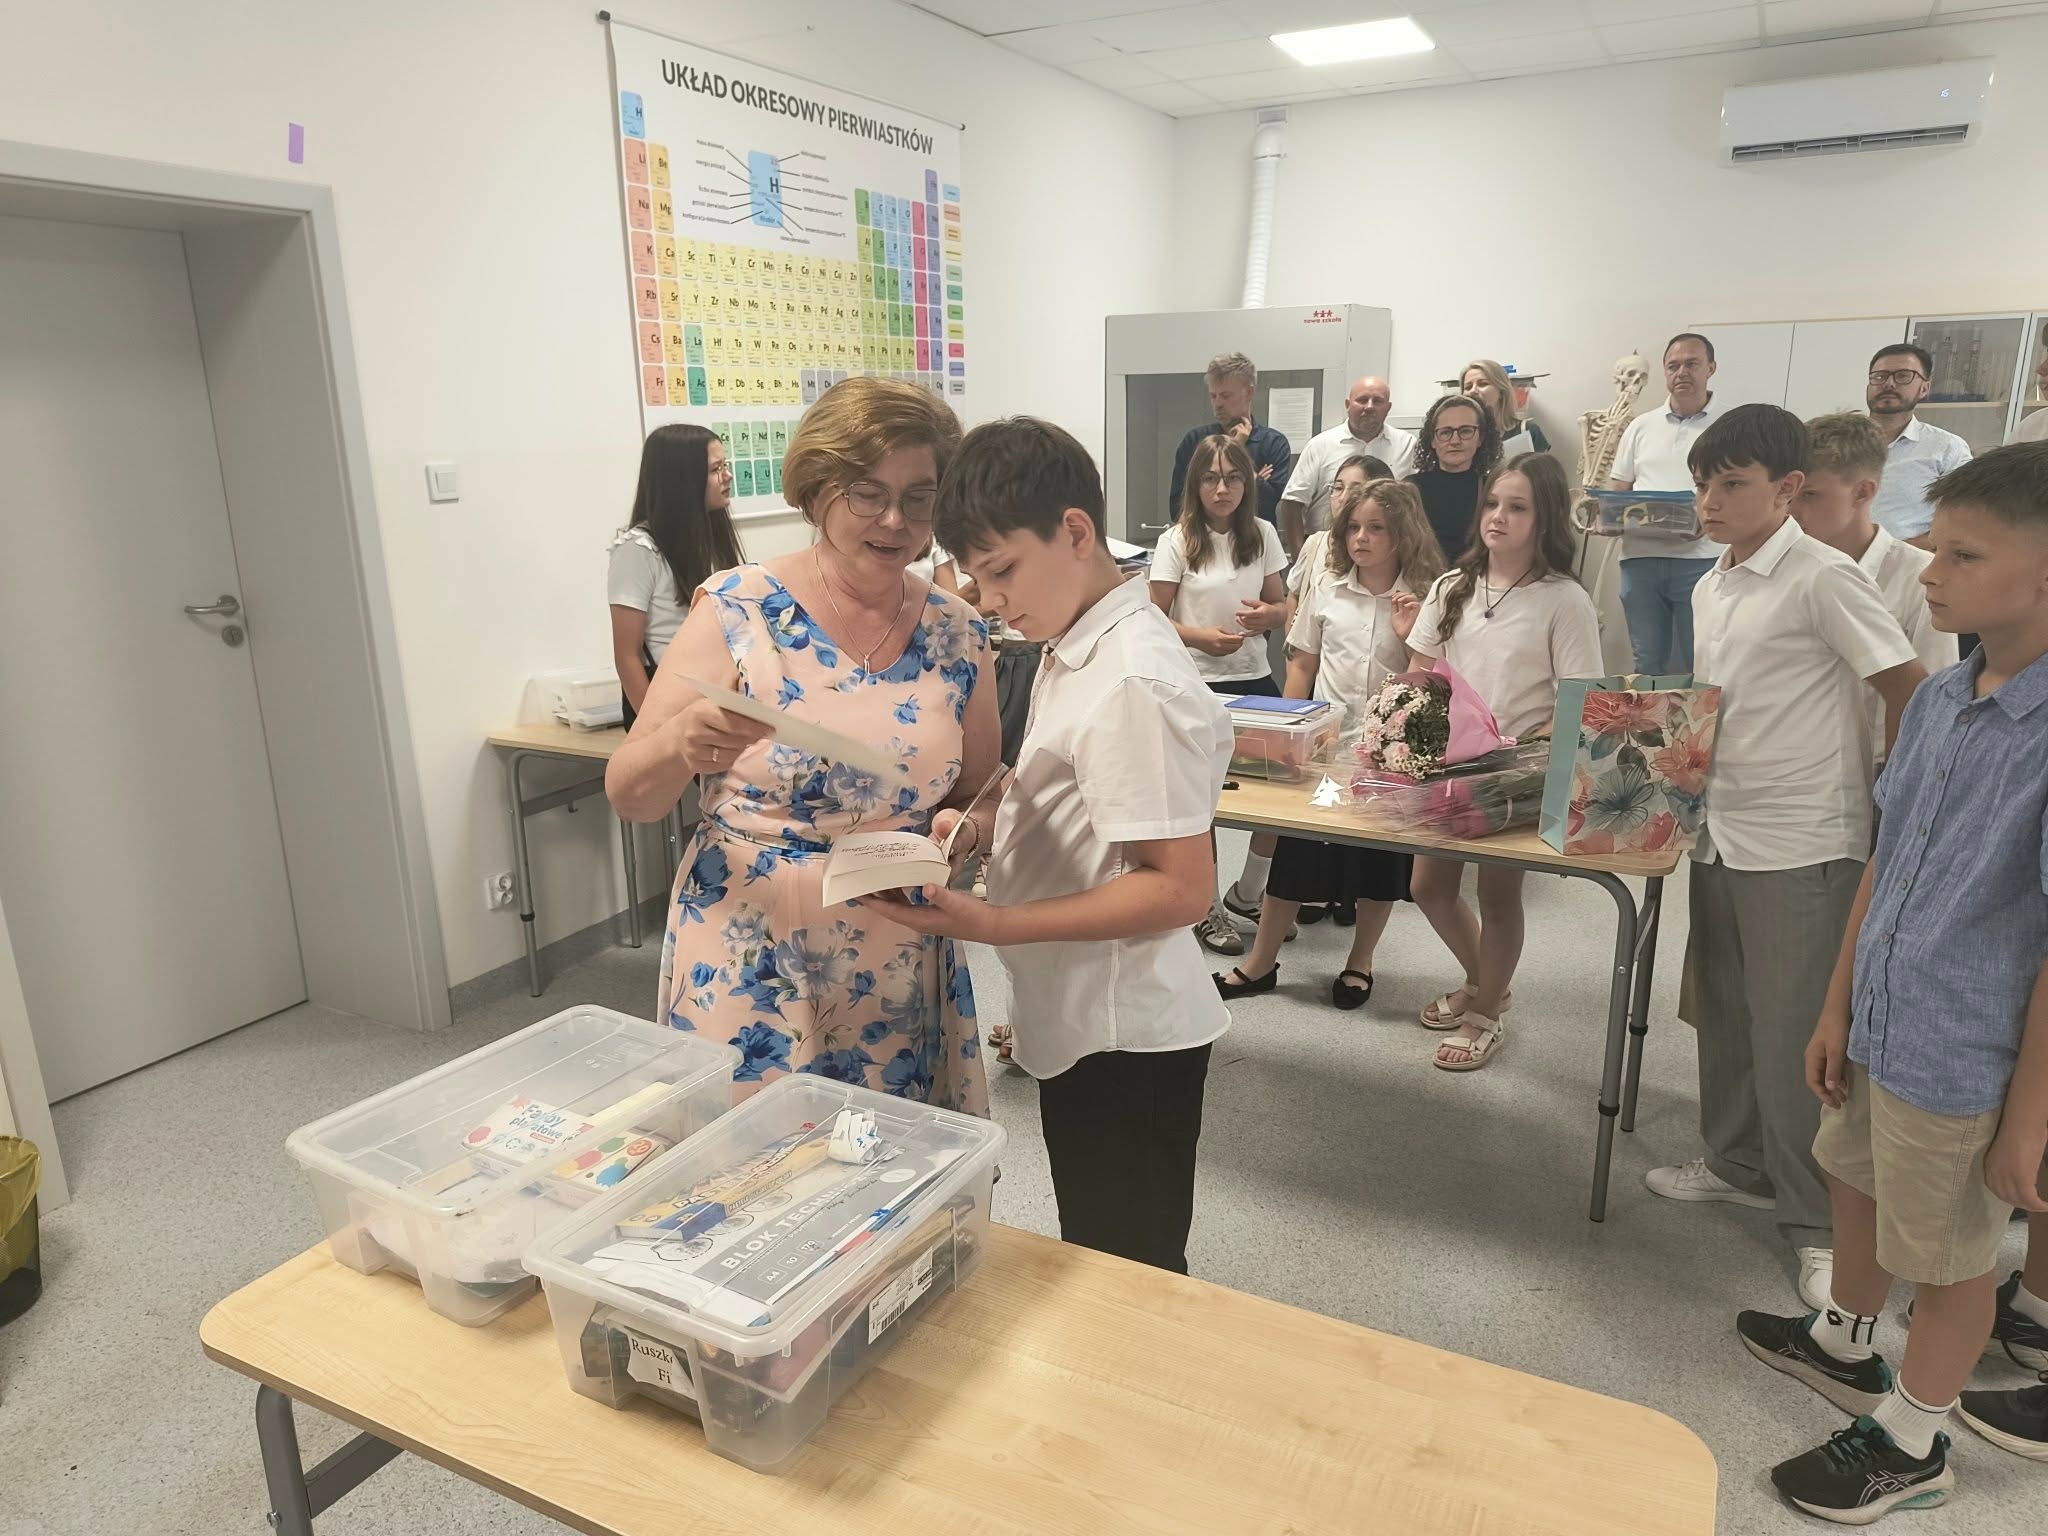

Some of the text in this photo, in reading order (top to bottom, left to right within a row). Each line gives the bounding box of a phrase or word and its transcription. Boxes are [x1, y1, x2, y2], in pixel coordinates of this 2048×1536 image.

[661, 58, 933, 155] UKŁAD OKRESOWY PIERWIASTKÓW
[770, 177, 779, 193] H
[651, 334, 660, 344] Cs
[673, 336, 682, 345] Ba
[656, 378, 664, 387] Fr
[676, 378, 685, 387] Ra
[735, 379, 745, 388] Db
[758, 432, 767, 440] Nd
[719, 1230, 779, 1270] BLOK
[766, 1271, 781, 1282] A4
[786, 1256, 798, 1265] 10
